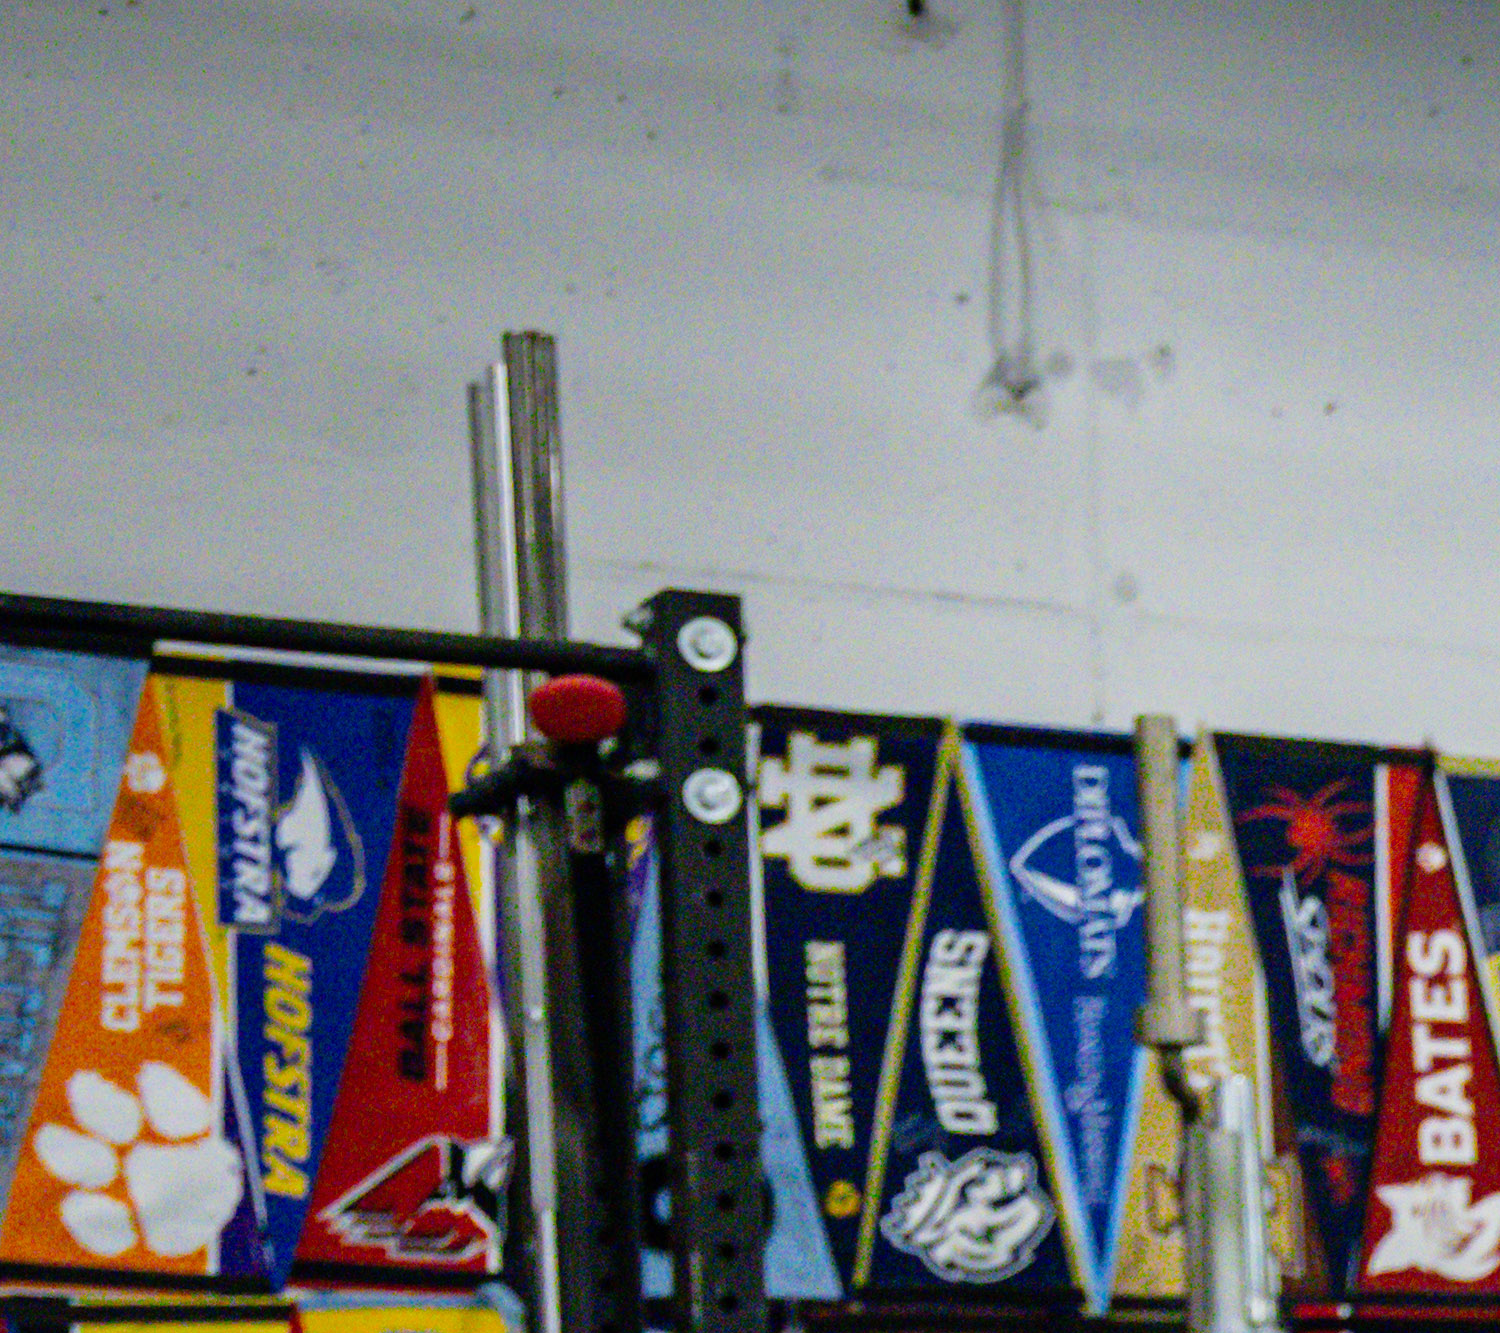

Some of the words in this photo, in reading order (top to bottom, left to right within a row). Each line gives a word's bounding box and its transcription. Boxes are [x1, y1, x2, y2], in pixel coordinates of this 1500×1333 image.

[229, 721, 275, 926] HOFSTRA
[101, 840, 146, 1034] CLEMSON
[144, 866, 188, 1012] TIGERS
[804, 940, 850, 1052] NOTRE
[920, 928, 998, 1137] QUEENS
[262, 942, 313, 1200] HOFSTRA
[810, 1055, 856, 1151] DAME
[1407, 926, 1478, 1166] BATES
